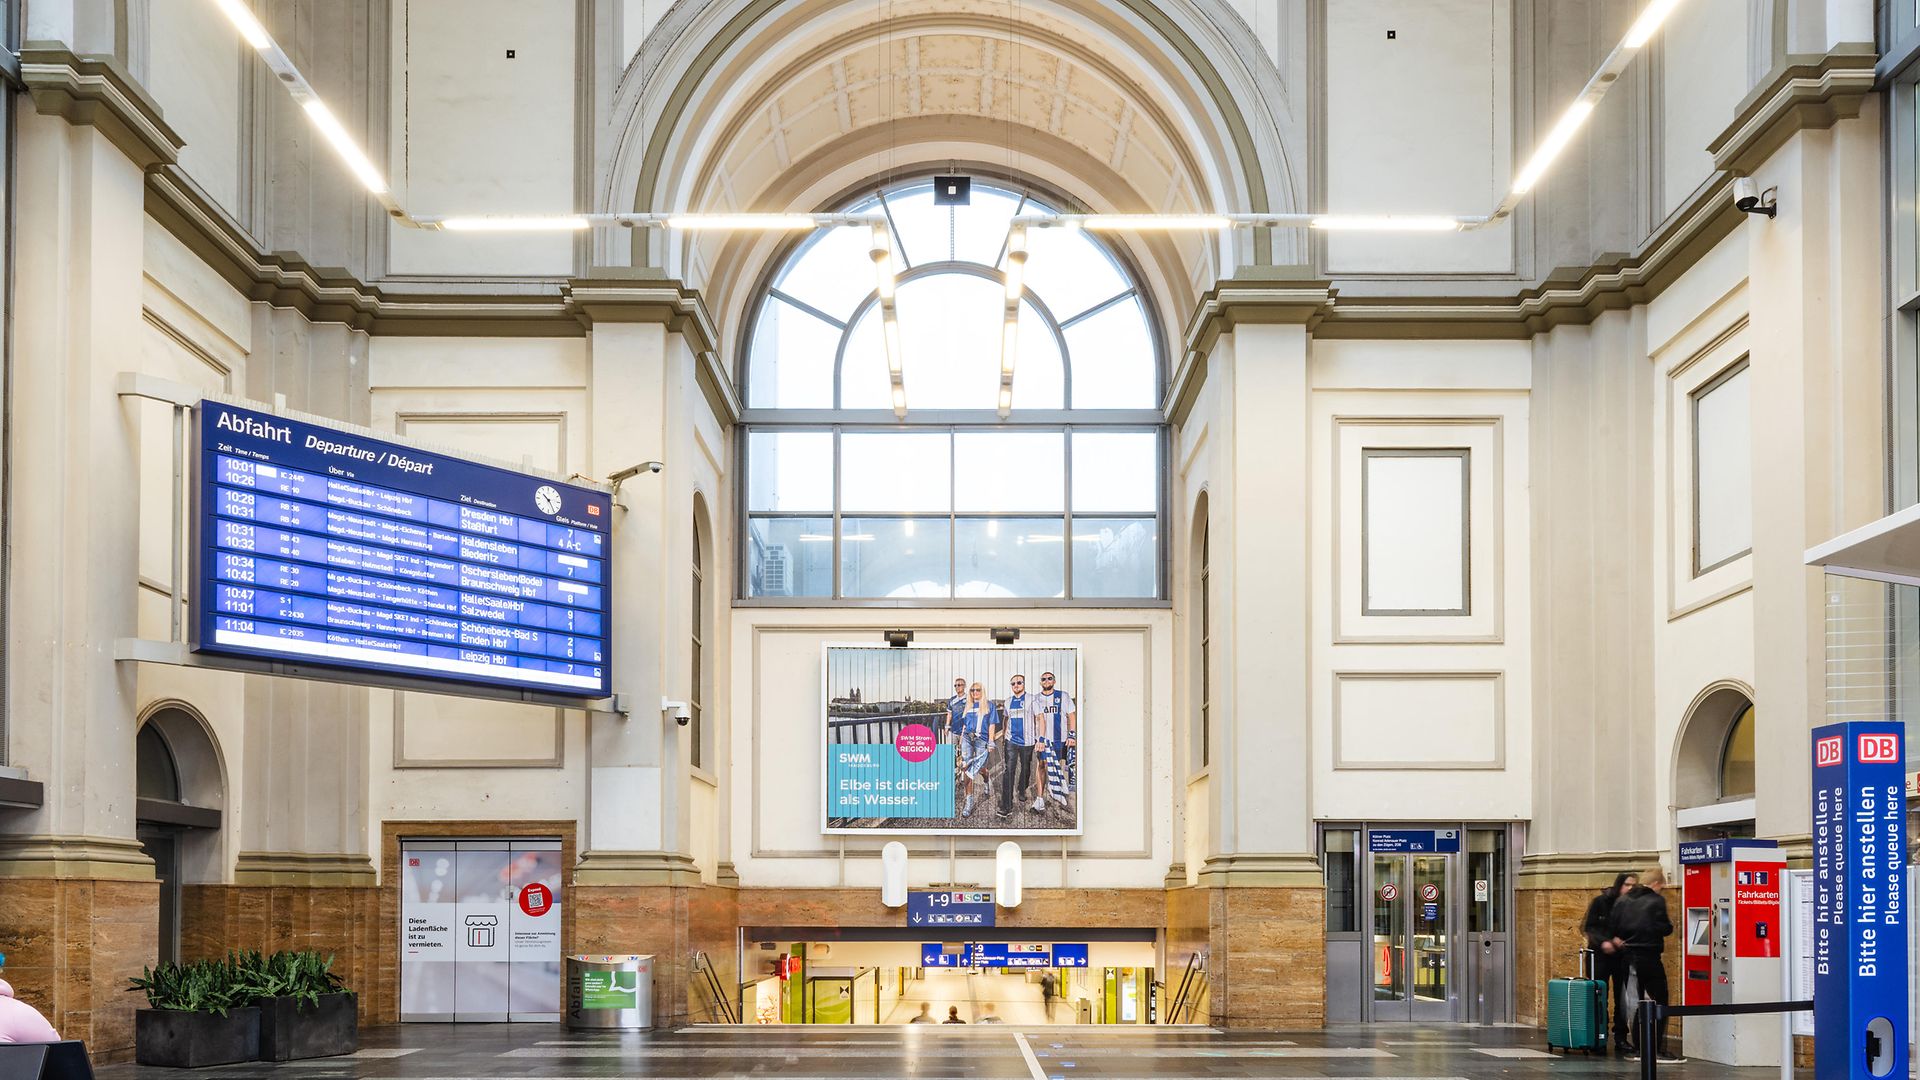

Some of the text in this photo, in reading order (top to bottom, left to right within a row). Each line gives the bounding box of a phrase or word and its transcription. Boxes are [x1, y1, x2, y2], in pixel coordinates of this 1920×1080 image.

[217, 412, 291, 444] Abfahrt
[218, 443, 232, 453] Zeit
[305, 435, 375, 462] Departure
[388, 454, 433, 475] Départ
[226, 459, 253, 472] 10:01
[329, 466, 344, 476] Über
[226, 472, 254, 485] 10:26
[226, 491, 254, 504] 10:28
[226, 504, 253, 517] 10:31
[461, 508, 513, 525] Dresden Hbf
[588, 505, 599, 515] DB
[226, 523, 253, 536] 10:31
[461, 519, 497, 534] Staßfurt
[568, 529, 572, 538] 7
[226, 536, 254, 549] 10:32
[461, 537, 516, 554] Haldensleben
[566, 540, 580, 550] A-C
[461, 548, 498, 562] Biederitz
[226, 556, 254, 568] 10:34
[226, 568, 254, 581] 10:42
[567, 567, 573, 575] 7
[461, 576, 536, 596] Braunschweig Hbf
[225, 588, 254, 599] 10:47
[567, 594, 573, 603] 8
[225, 600, 252, 612] 11:01
[461, 605, 504, 619] Salzwedel
[567, 610, 572, 619] 9
[225, 620, 253, 631] 11:04
[461, 634, 507, 647] Emden Hbf
[532, 632, 538, 641] S
[567, 638, 573, 646] 2
[461, 651, 506, 664] Leipzig Hbf
[567, 648, 573, 657] 6
[568, 664, 572, 672] 7
[1819, 740, 1840, 763] DB
[1864, 738, 1893, 758] DB
[840, 753, 870, 763] SWM
[840, 779, 939, 790] Elbe ist dicker
[840, 794, 918, 805] als Wasser.
[1833, 787, 1844, 925] Please queue here
[1884, 786, 1902, 925] Please queue here
[1816, 790, 1829, 975] Bitte hier anstellen
[1857, 786, 1876, 977] Bitte hier anstellen
[928, 894, 949, 906] 1-9
[571, 977, 580, 1019] Abfall
